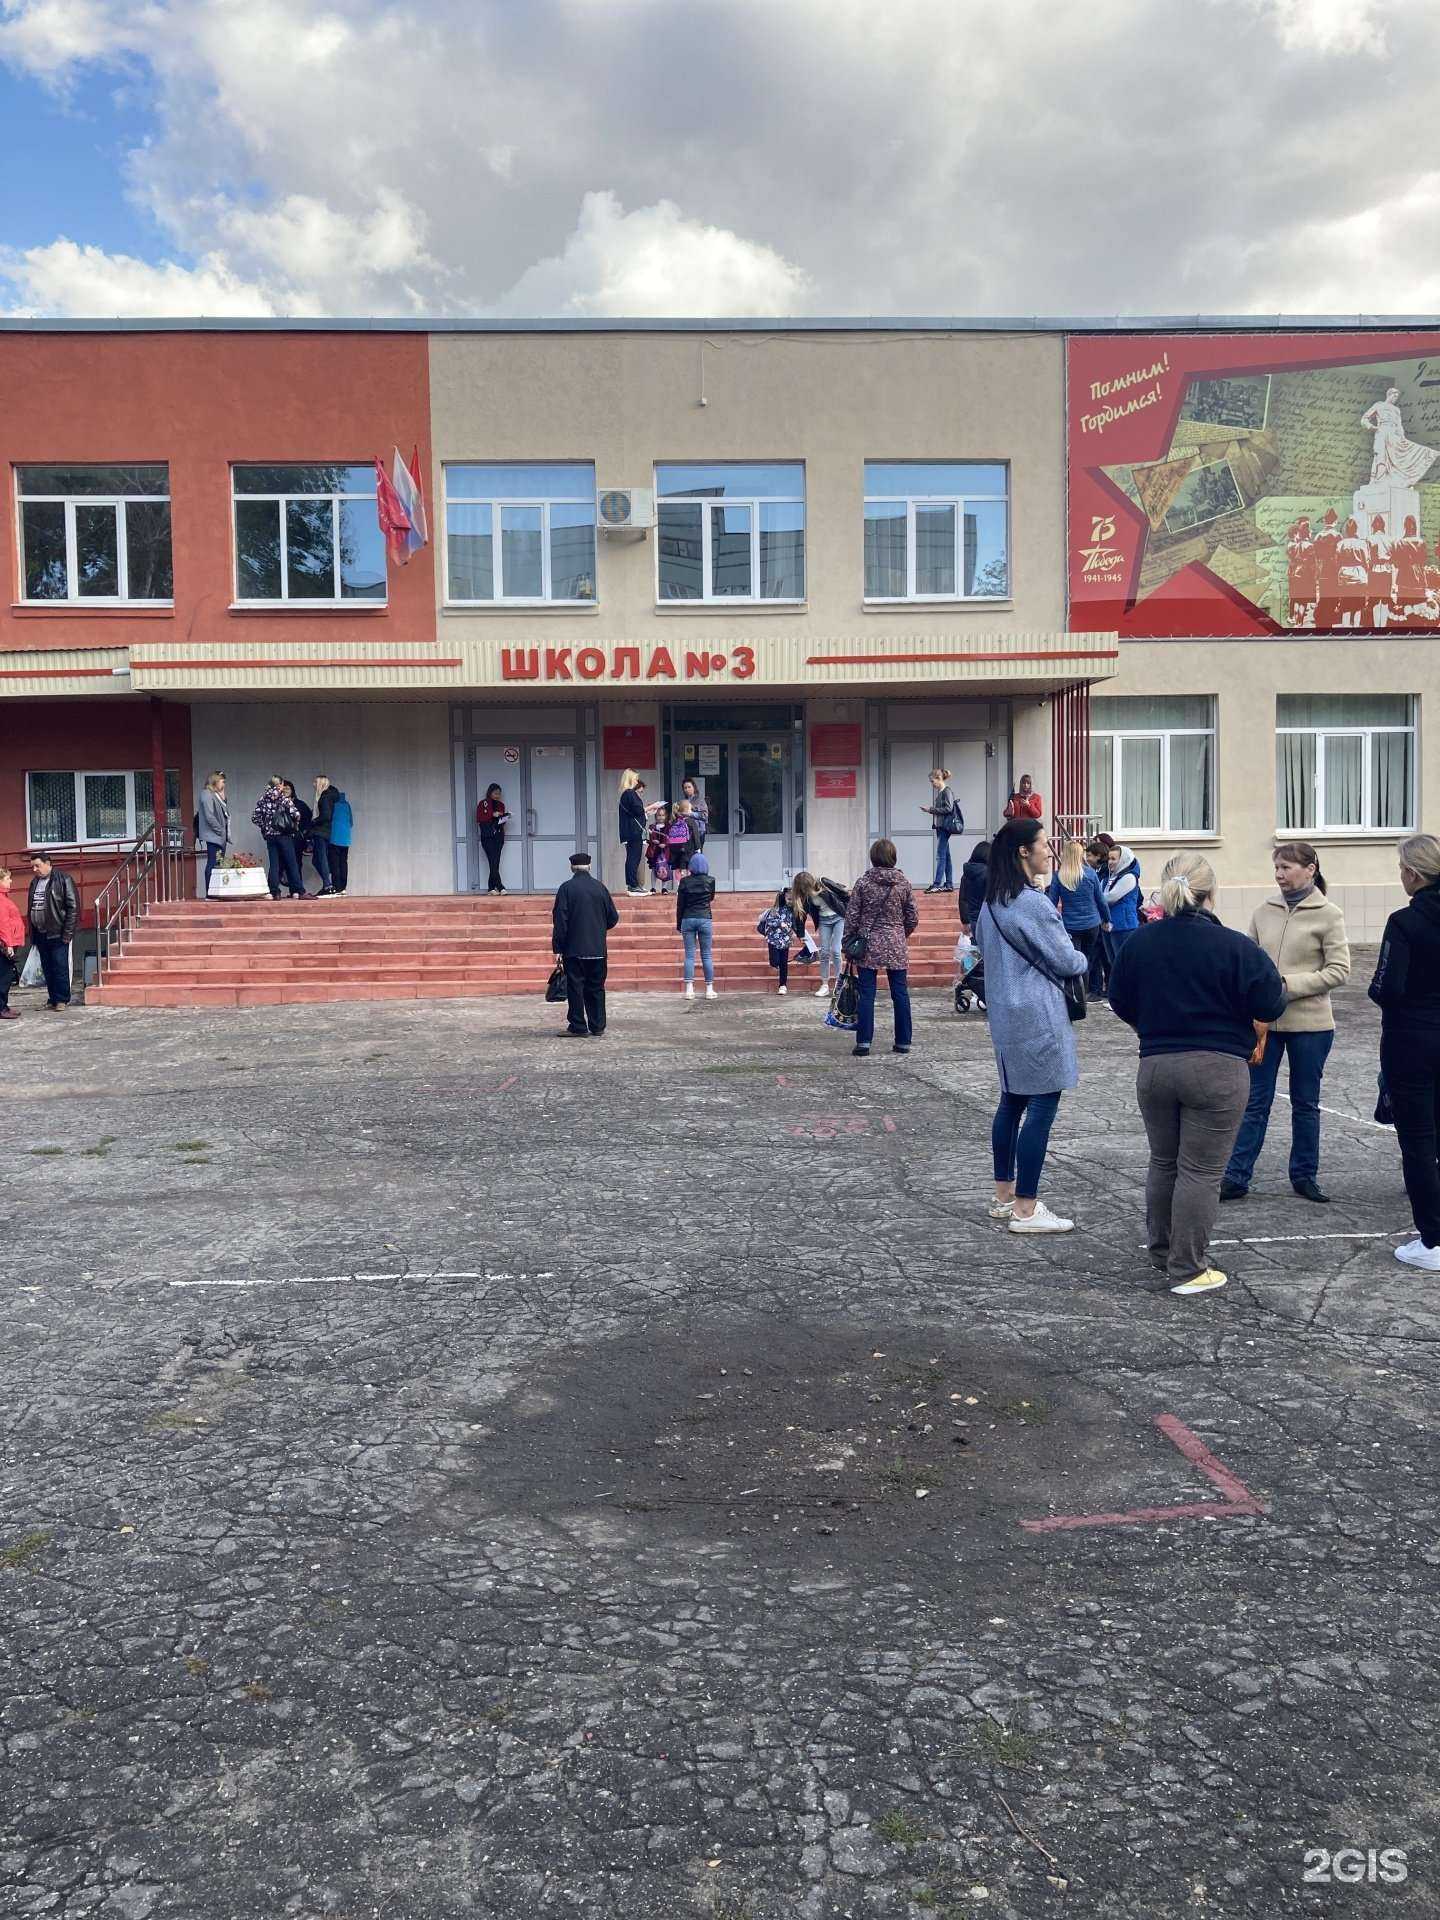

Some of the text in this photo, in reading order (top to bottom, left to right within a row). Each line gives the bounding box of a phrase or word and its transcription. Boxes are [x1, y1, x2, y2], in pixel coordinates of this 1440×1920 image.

[1089, 351, 1170, 400] Помним!
[1080, 381, 1163, 434] Гордимся!
[1090, 514, 1117, 542] 75
[1083, 574, 1122, 582] 1941-1945
[501, 646, 677, 680] ШКОЛА
